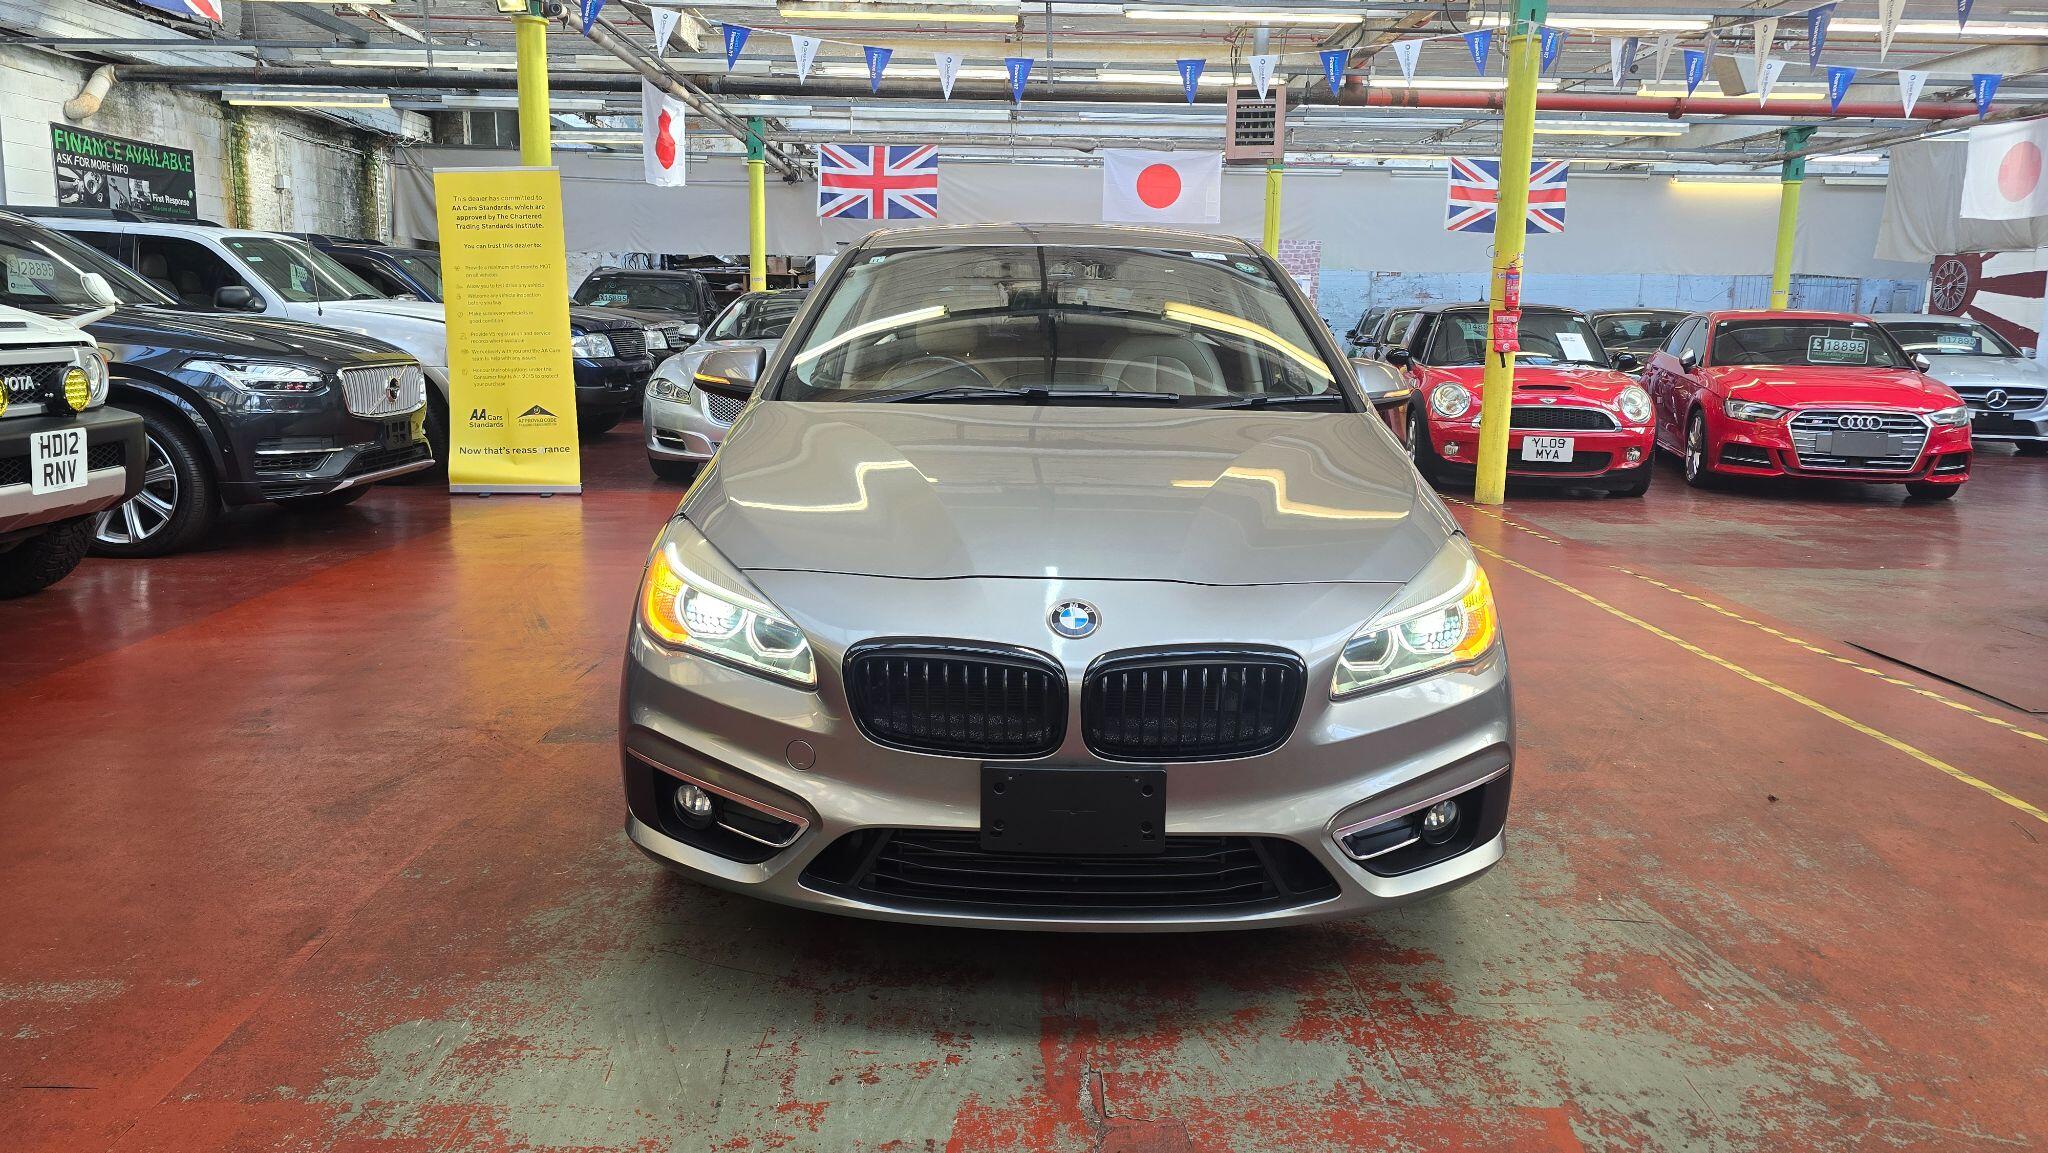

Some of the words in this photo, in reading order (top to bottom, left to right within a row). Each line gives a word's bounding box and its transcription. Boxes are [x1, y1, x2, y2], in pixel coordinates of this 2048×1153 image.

[1812, 16, 1822, 46] Finance
[1546, 33, 1554, 51] Finance
[54, 129, 123, 161] FINANCE
[126, 144, 192, 173] AVAILABLE
[56, 153, 72, 165] ASK
[74, 155, 90, 167] FOR
[91, 159, 111, 171] MORE
[112, 162, 129, 175] INFO
[152, 193, 165, 203] First
[165, 195, 190, 206] Response
[469, 409, 486, 420] AA
[39, 432, 79, 460] HD12
[459, 447, 481, 455] Now
[1533, 437, 1566, 449] YL09
[1535, 449, 1559, 459] MYA
[43, 459, 77, 487] RNV
